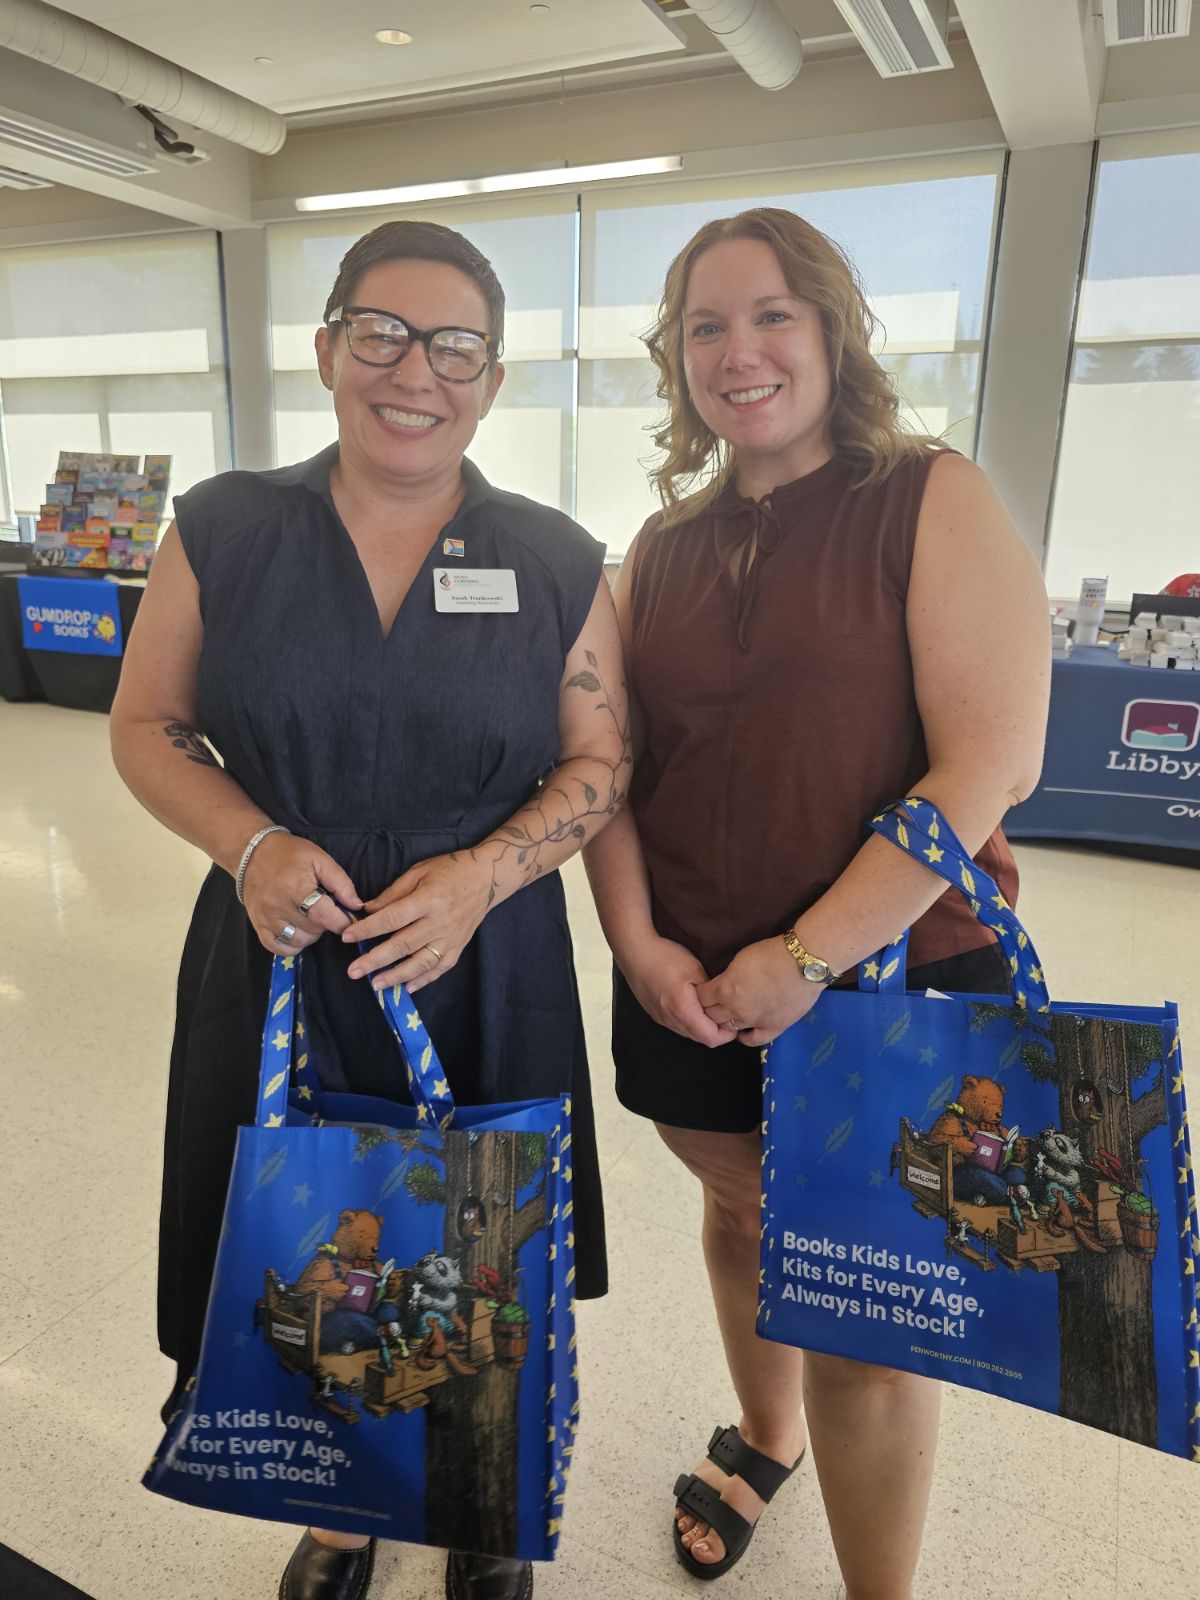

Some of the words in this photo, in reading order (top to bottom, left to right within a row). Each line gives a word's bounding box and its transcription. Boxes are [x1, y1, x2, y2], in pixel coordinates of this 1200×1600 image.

[26, 606, 91, 625] GUMDROP
[53, 624, 89, 638] BOOKS
[783, 1230, 847, 1260] Books
[851, 1243, 900, 1271] Kids
[905, 1254, 967, 1287] Love,
[782, 1256, 822, 1282] Kits
[825, 1265, 858, 1288] for
[861, 1272, 926, 1307] Every
[930, 1286, 986, 1318] Age,
[781, 1283, 861, 1318] Always
[865, 1297, 887, 1322] in
[892, 1304, 967, 1339] Stock!
[910, 1345, 972, 1367] PENWORTHY.COM
[216, 1408, 271, 1429] Kids
[275, 1410, 335, 1439] Love,
[189, 1435, 225, 1455] for
[229, 1437, 296, 1461] Every
[301, 1439, 352, 1468] Age,
[233, 1461, 257, 1480] in
[262, 1462, 337, 1487] Stock!
